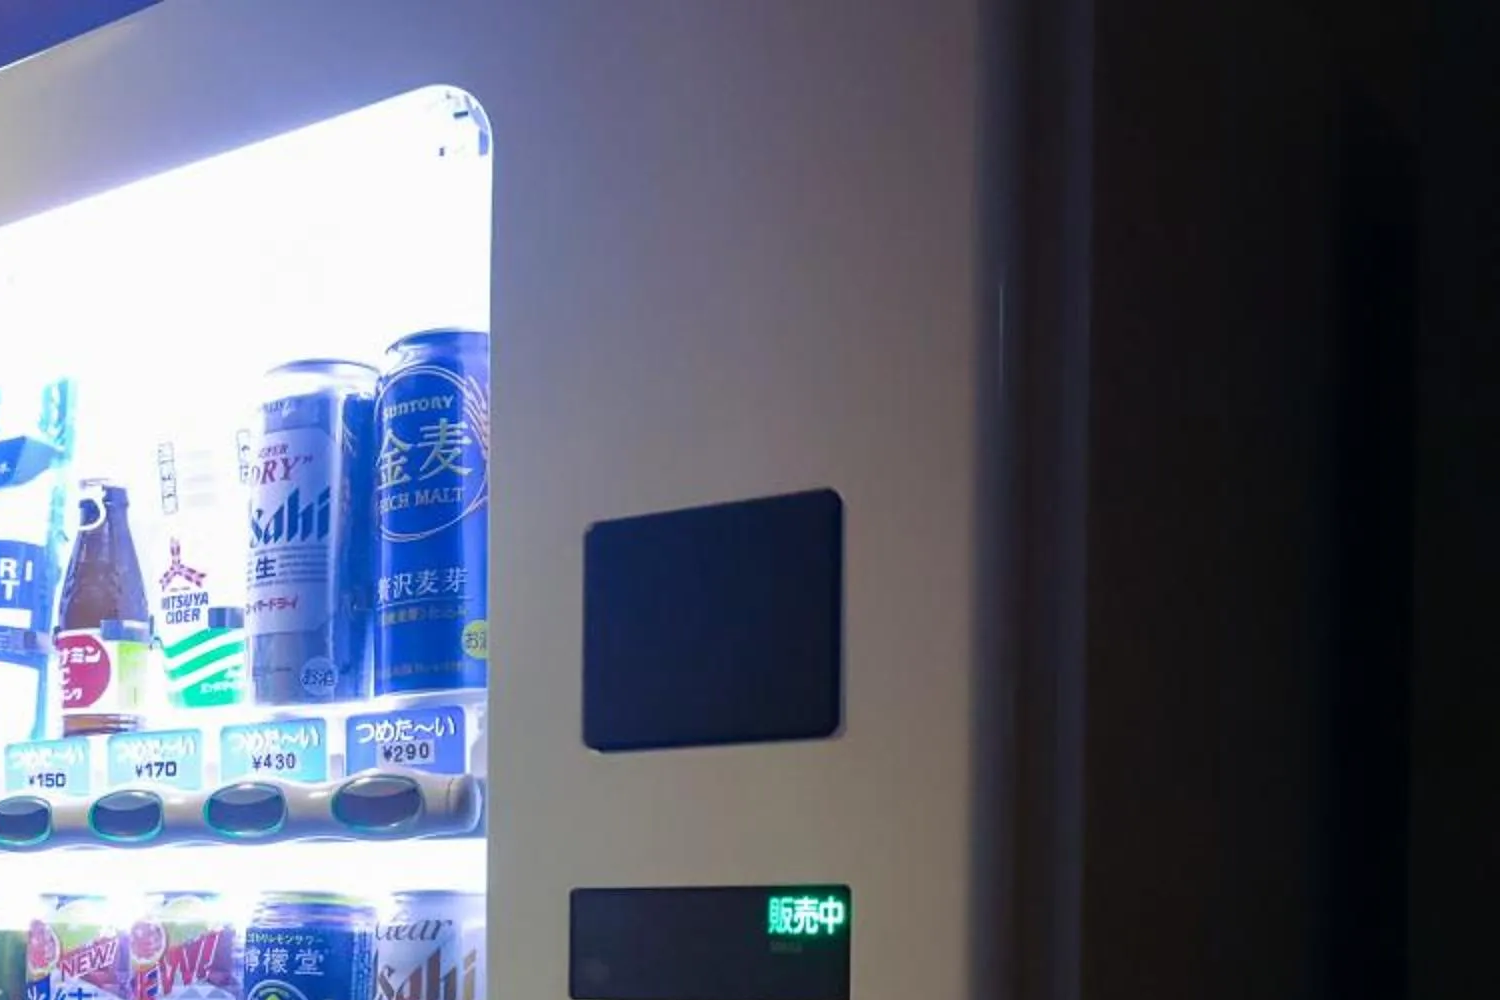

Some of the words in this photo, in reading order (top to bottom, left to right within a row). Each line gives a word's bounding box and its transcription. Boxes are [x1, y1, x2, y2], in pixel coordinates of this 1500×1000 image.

[377, 418, 472, 489] 金麦
[415, 487, 465, 506] MALT
[383, 743, 430, 761] ¥290
[135, 761, 177, 777] ¥170
[252, 753, 296, 770] ¥430
[768, 895, 845, 935] 販売中
